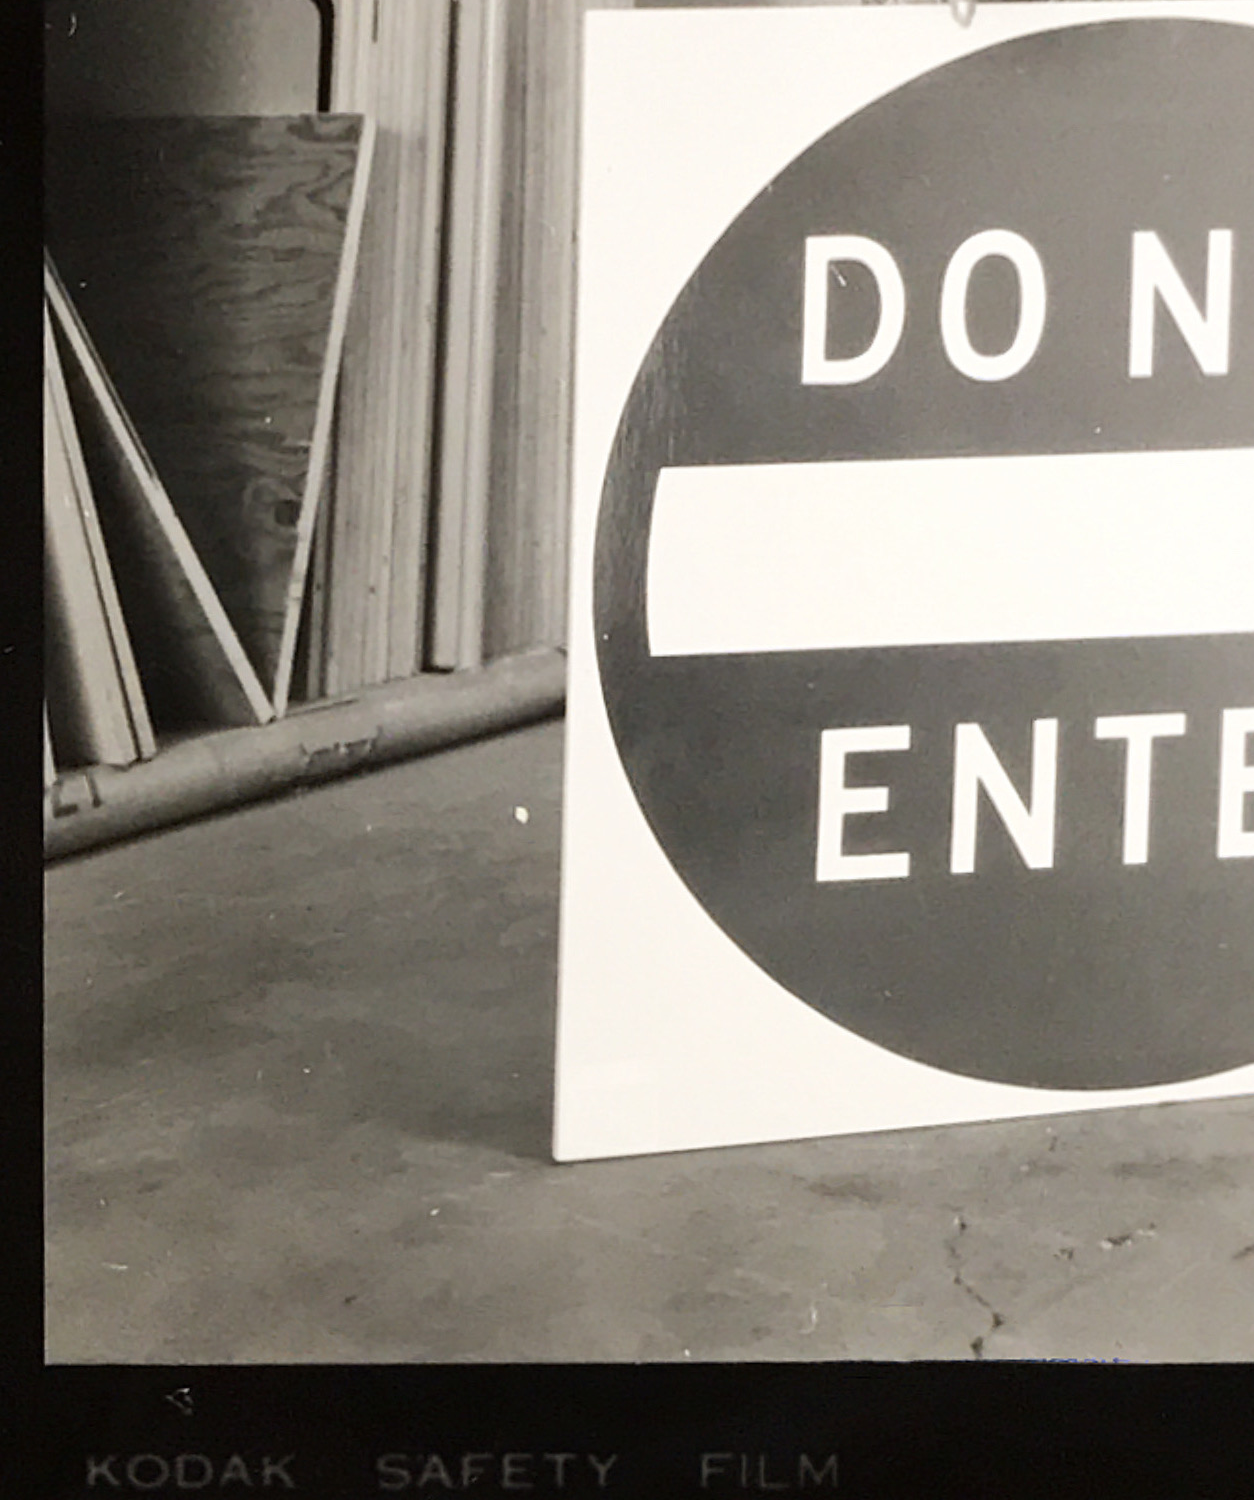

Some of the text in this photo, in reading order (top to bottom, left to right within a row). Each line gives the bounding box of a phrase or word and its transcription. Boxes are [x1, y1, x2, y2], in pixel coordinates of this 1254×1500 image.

[799, 227, 1049, 387] DO
[86, 1453, 839, 1490] KODAK SAFETY FILM
